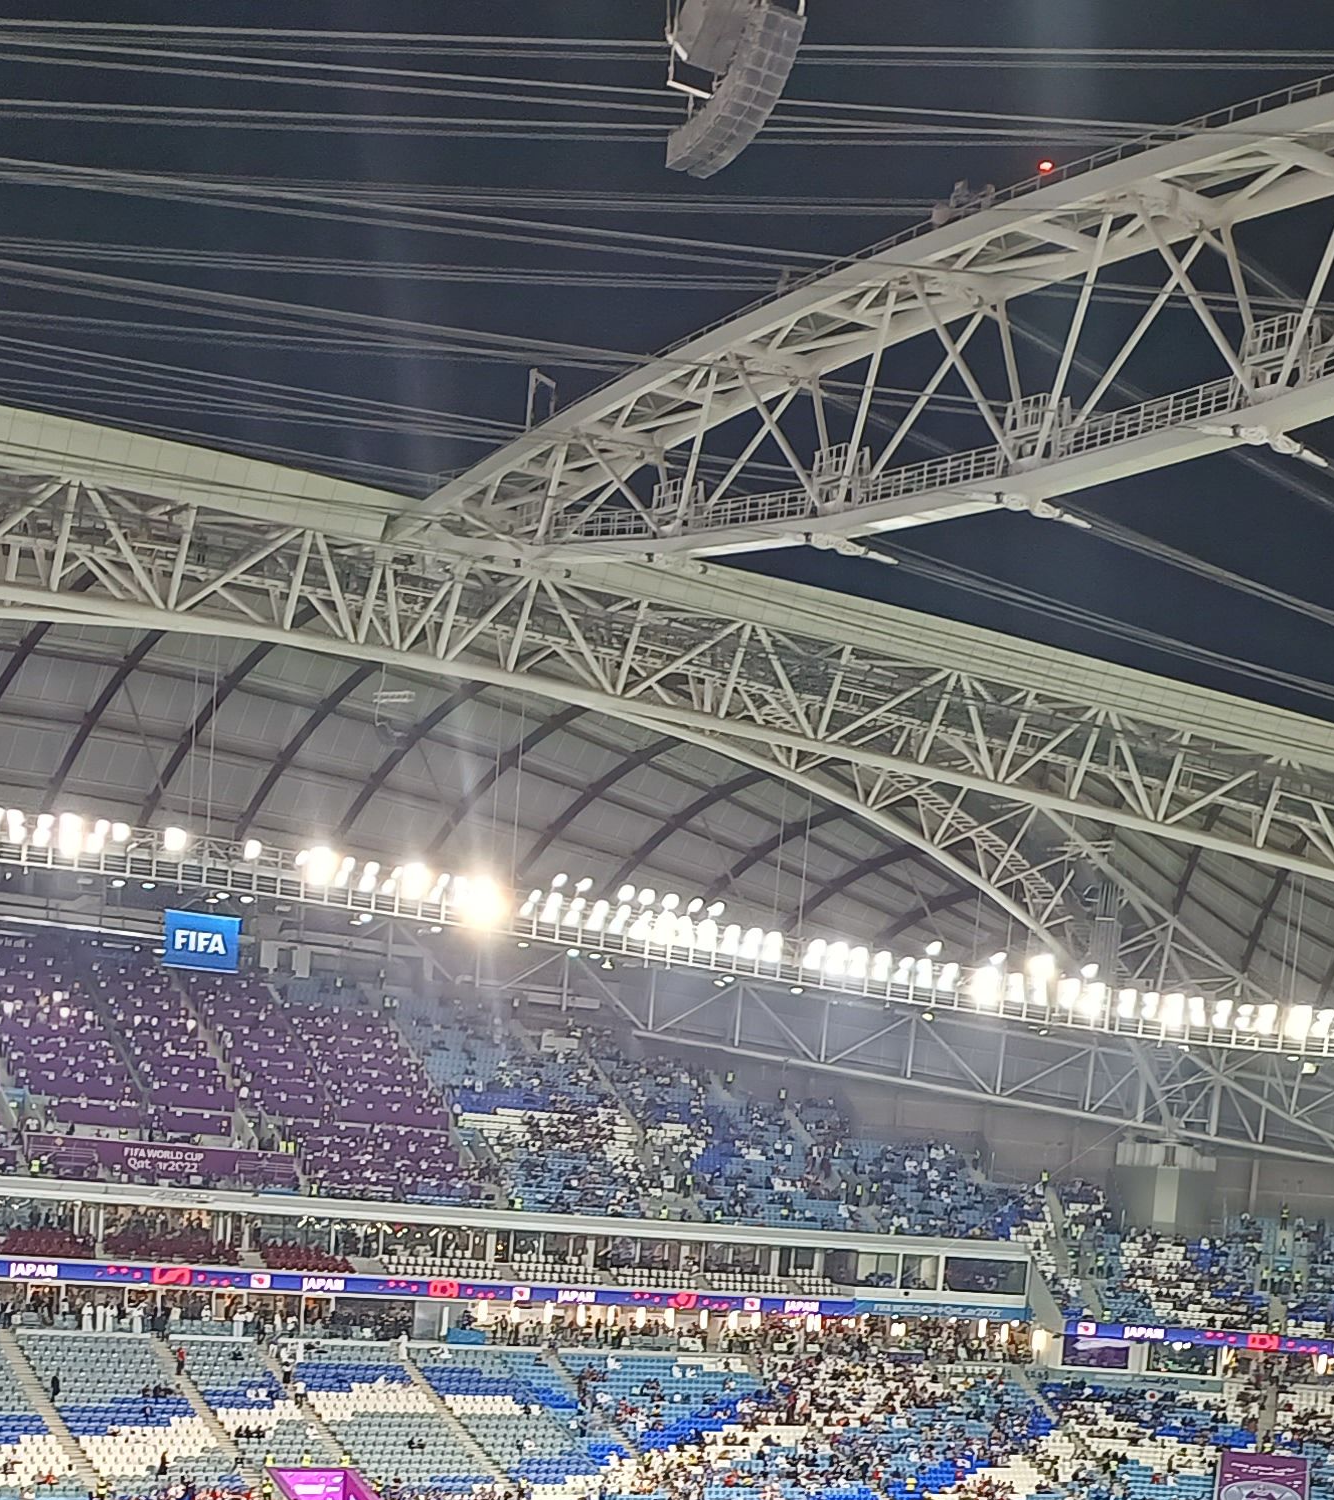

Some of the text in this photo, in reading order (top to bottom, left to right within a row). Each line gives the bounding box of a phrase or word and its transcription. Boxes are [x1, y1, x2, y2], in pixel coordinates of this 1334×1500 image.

[174, 929, 227, 955] FIFA
[123, 1147, 204, 1162] FIFA WORLD CUP
[9, 1261, 59, 1278] JAPAN
[302, 1277, 345, 1292] JAPAN
[557, 1290, 596, 1303] JAPAN
[784, 1300, 819, 1312] JAPAN
[1123, 1325, 1165, 1340] JAPAN
